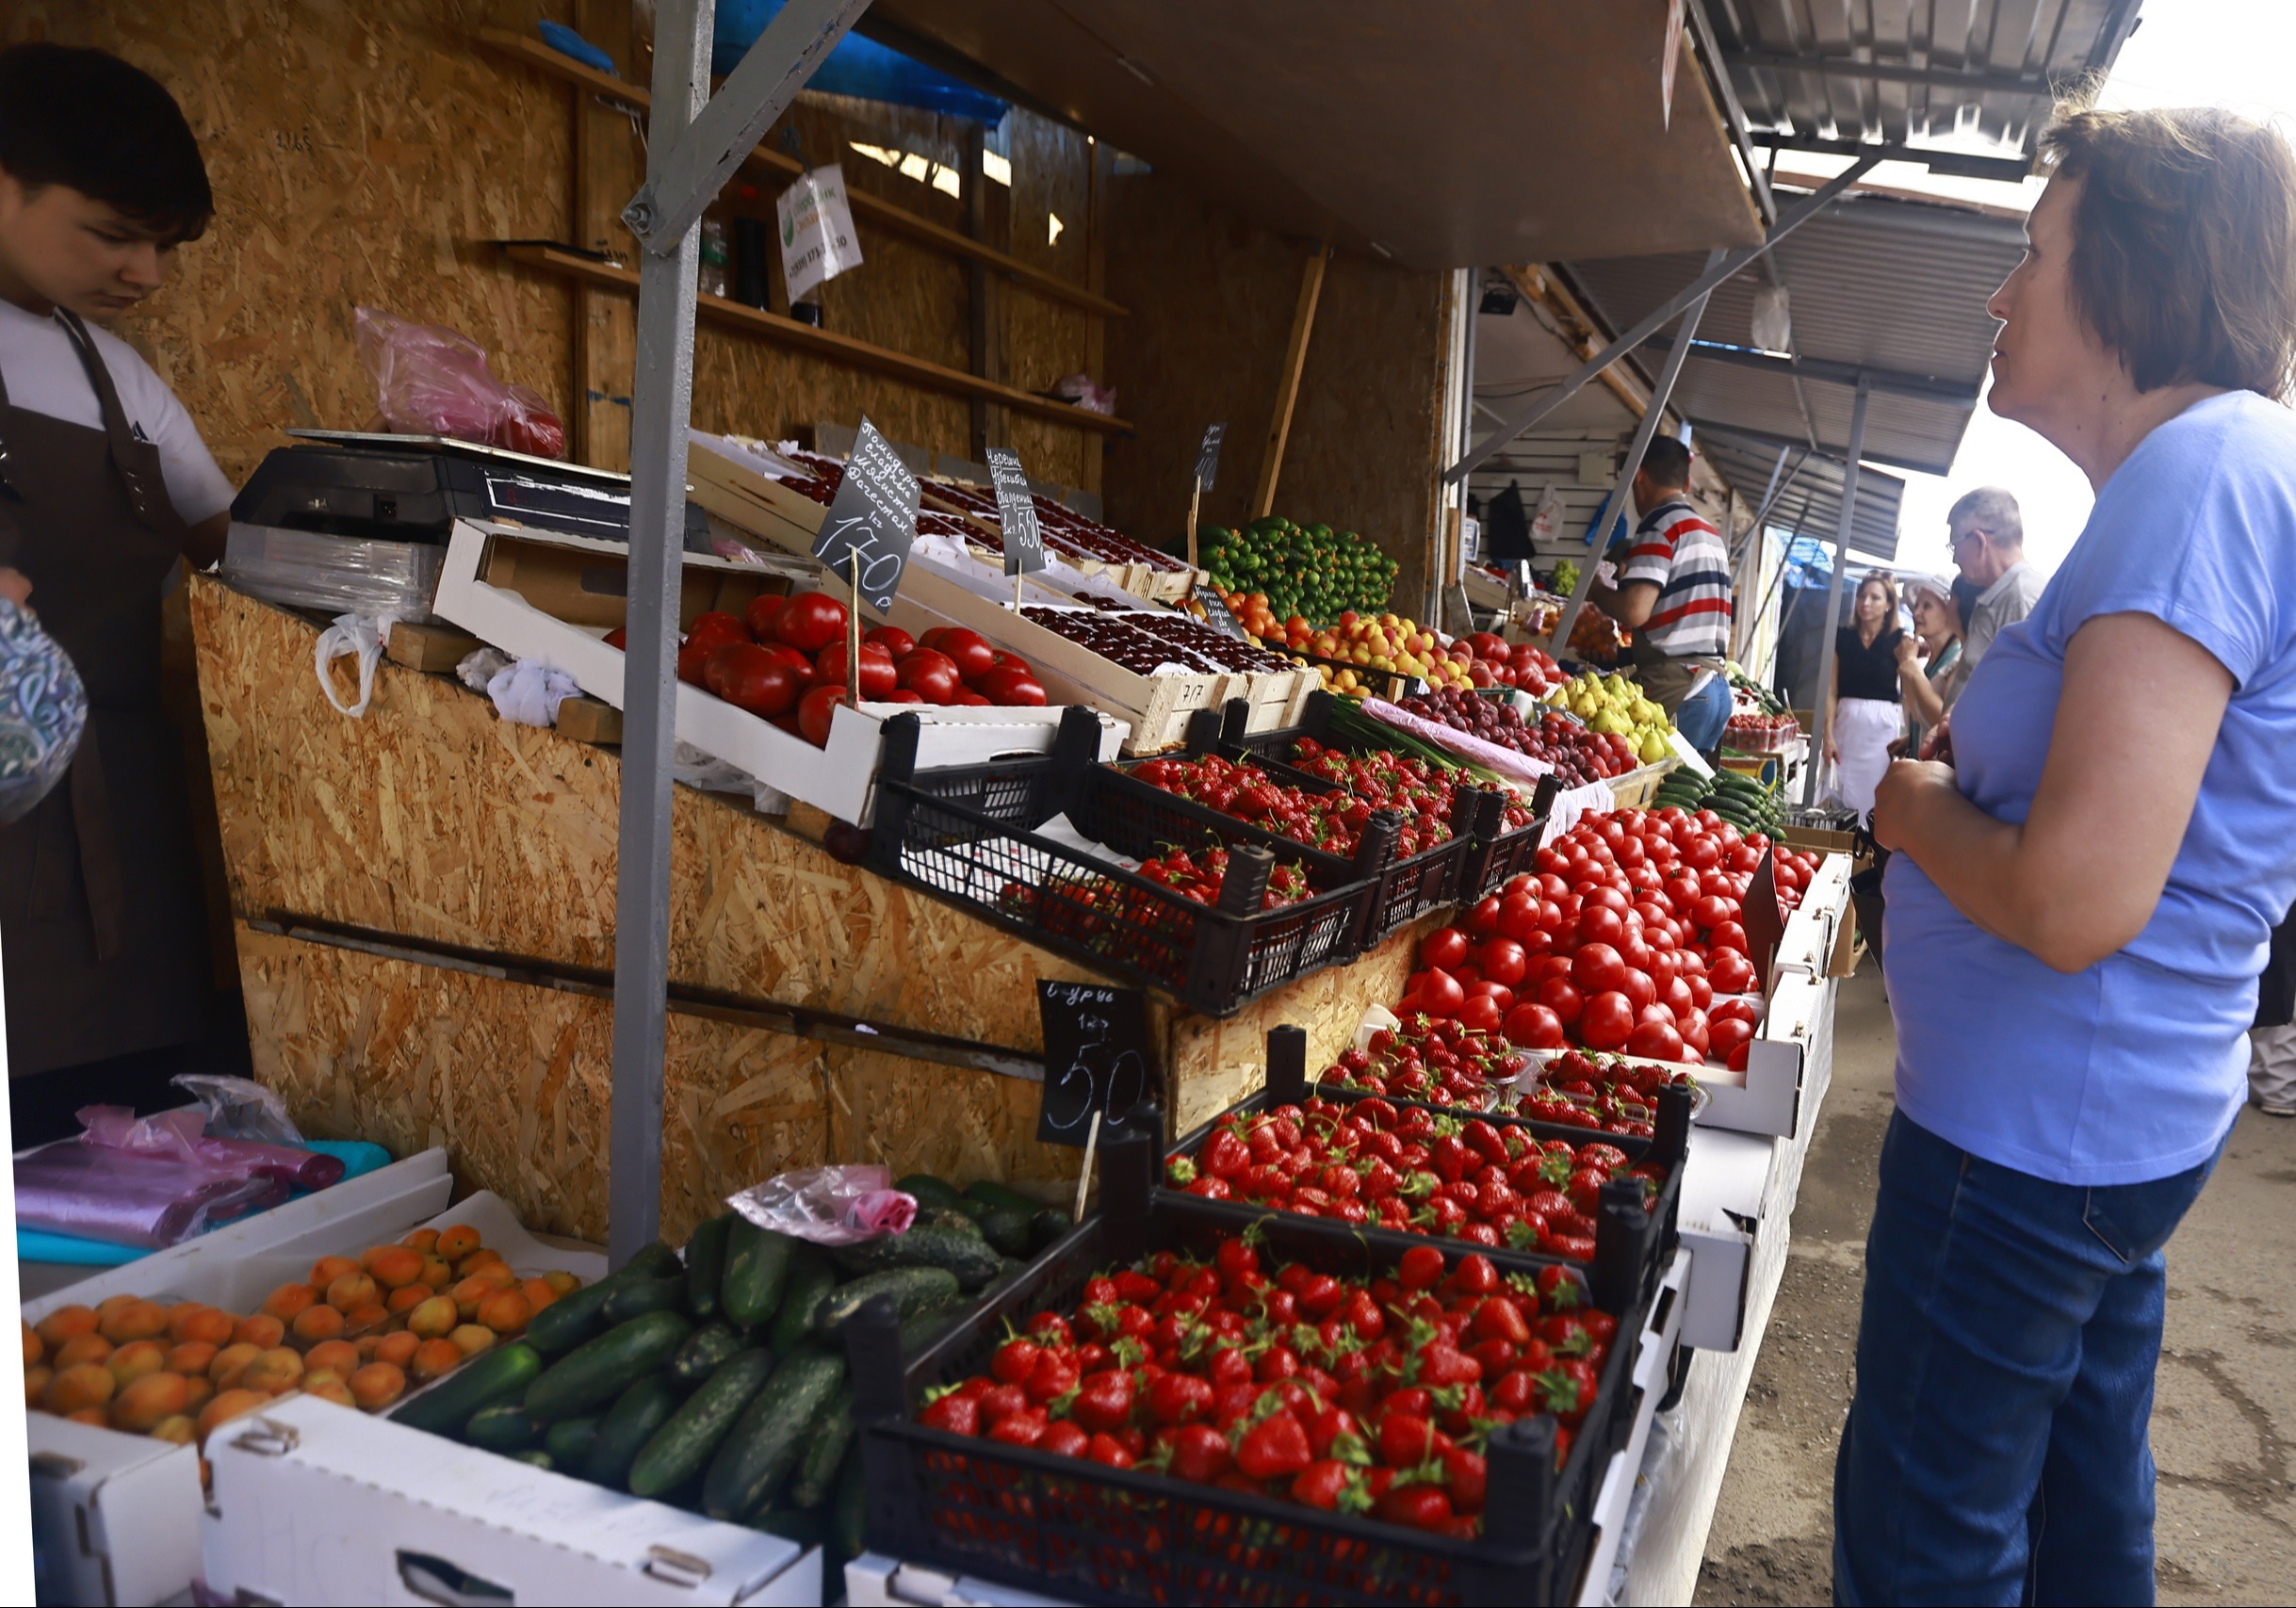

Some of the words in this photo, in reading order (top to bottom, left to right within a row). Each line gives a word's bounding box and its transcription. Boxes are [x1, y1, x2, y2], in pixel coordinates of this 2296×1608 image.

[816, 516, 902, 592] 170
[1018, 510, 1041, 548] 550
[1047, 1042, 1144, 1129] 50
